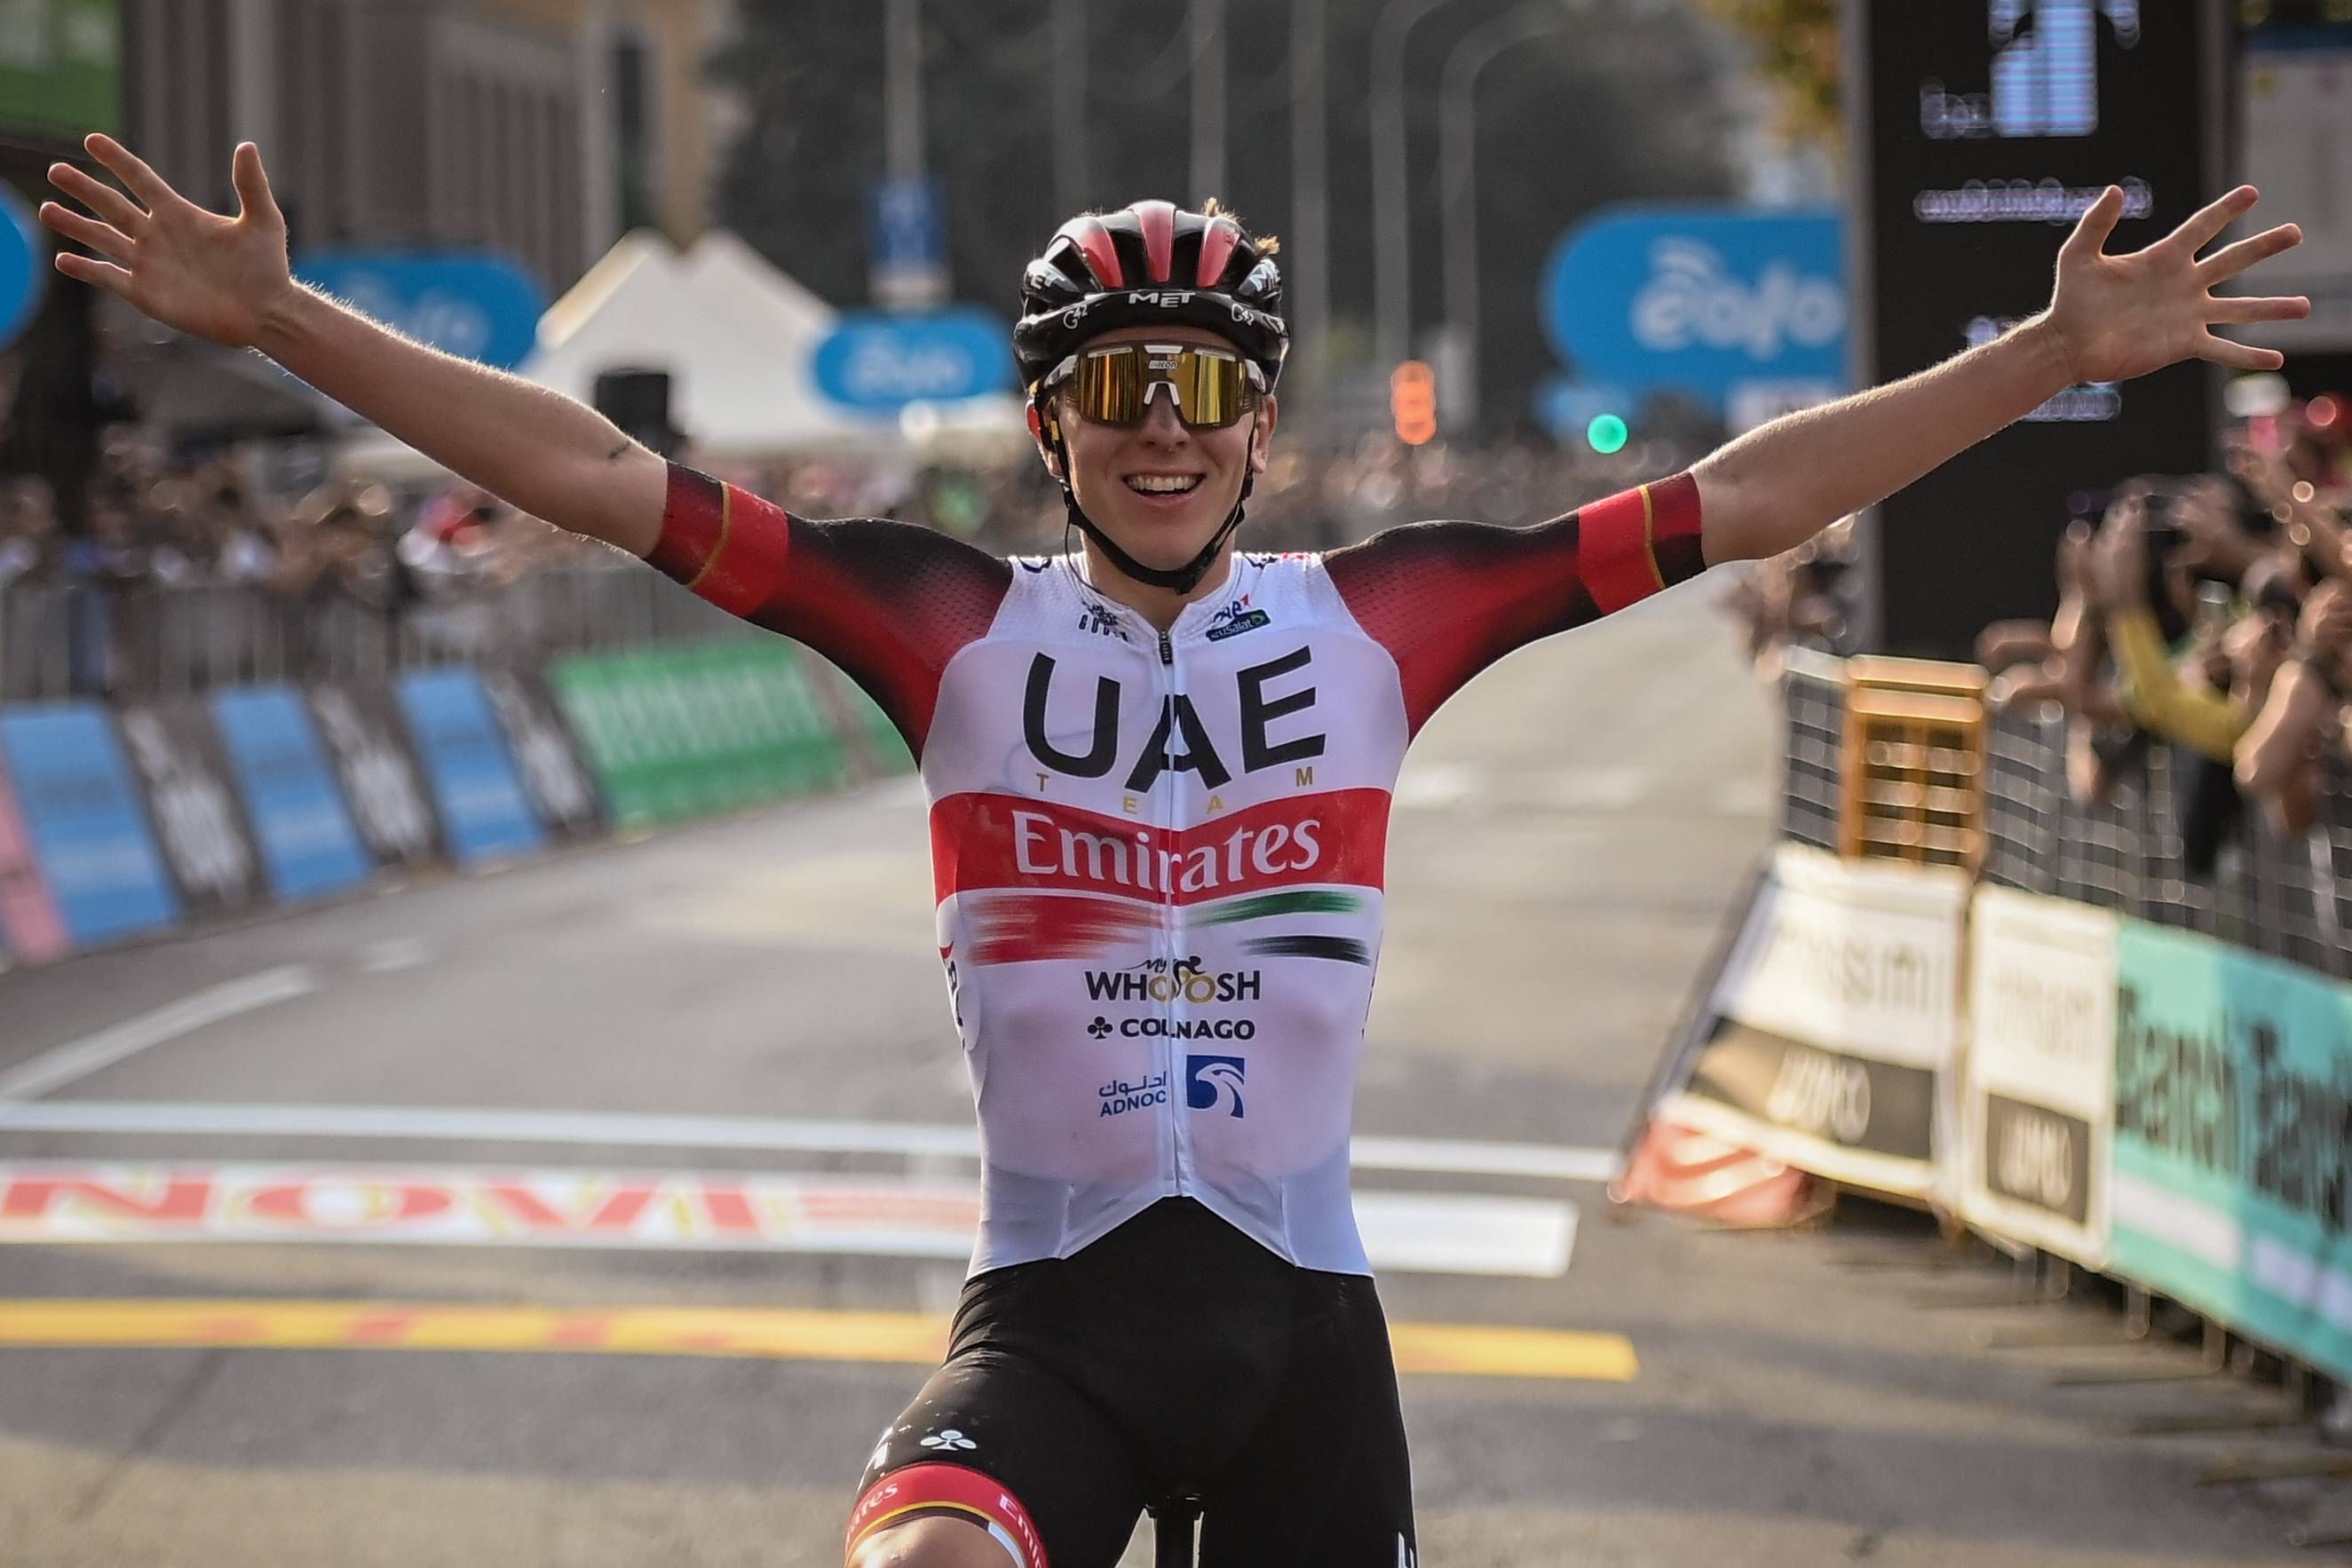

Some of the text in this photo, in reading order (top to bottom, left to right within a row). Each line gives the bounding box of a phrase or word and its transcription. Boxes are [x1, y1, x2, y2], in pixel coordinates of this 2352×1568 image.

[1128, 292, 1197, 308] MET
[1023, 645, 1326, 793] UAE
[1012, 810, 1320, 895] Emirates
[1084, 970, 1260, 1003] WHOOSH
[1120, 1018, 1255, 1040] COLNAGO
[1100, 1089, 1167, 1118] ADNOC
